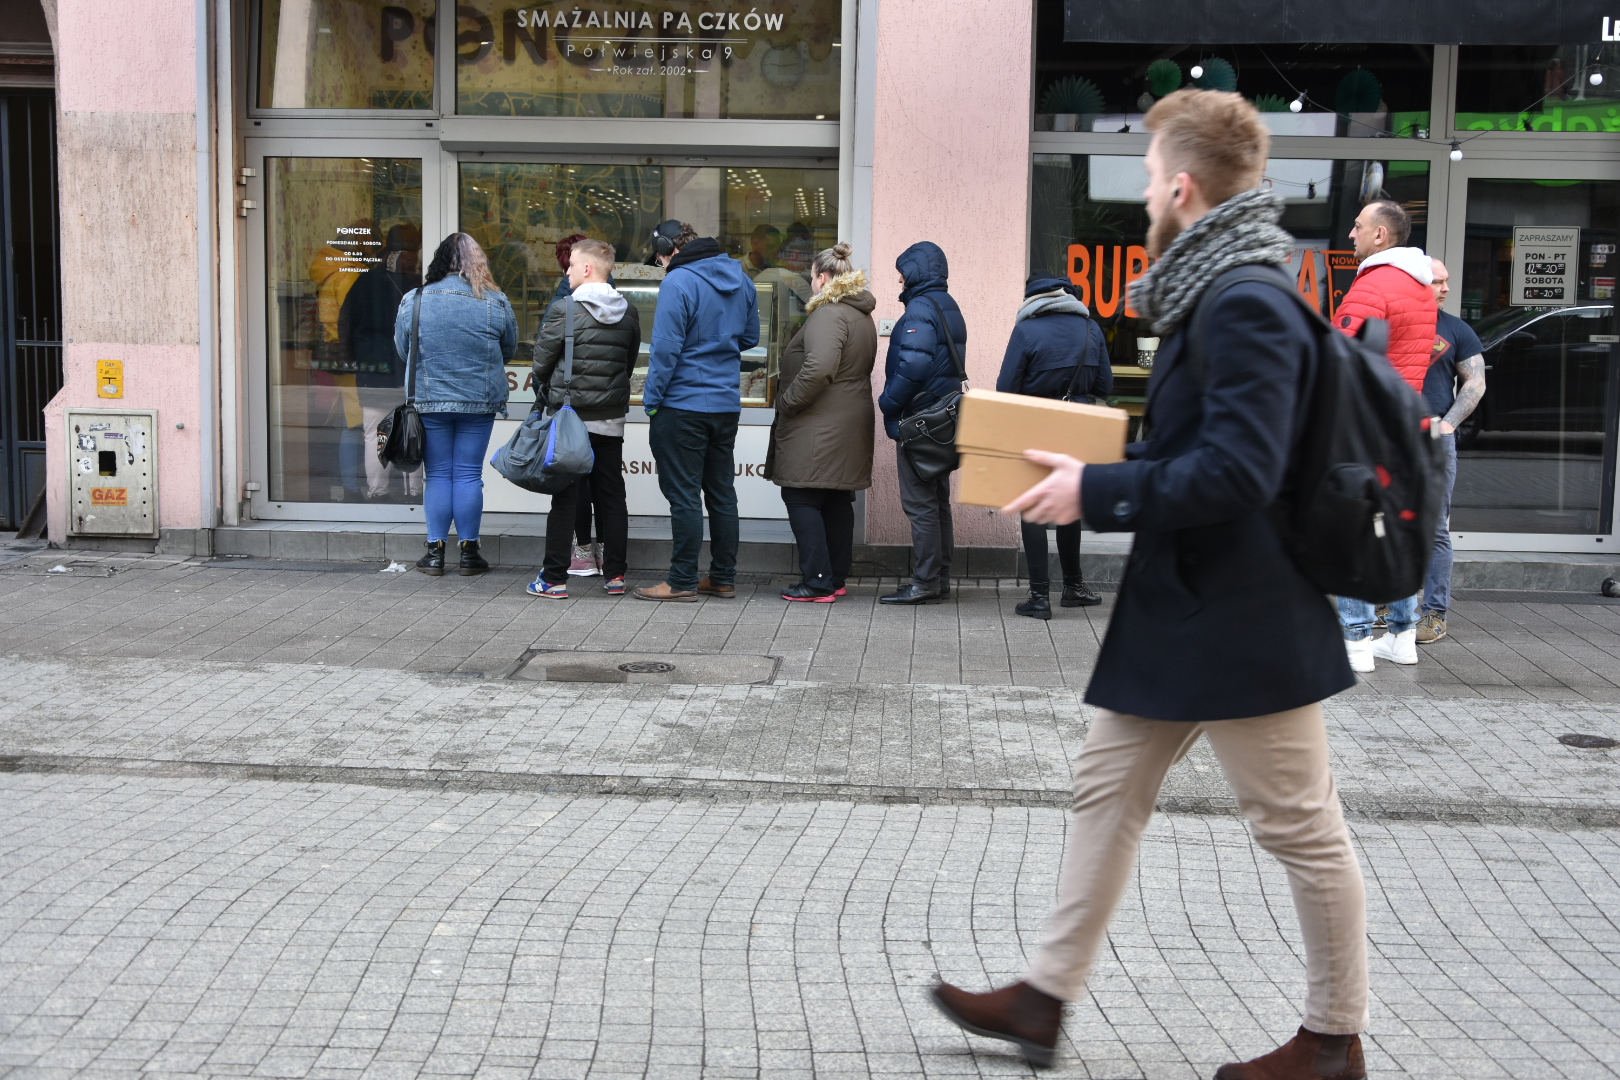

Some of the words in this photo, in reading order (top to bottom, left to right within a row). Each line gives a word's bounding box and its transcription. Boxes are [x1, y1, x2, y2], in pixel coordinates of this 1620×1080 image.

[517, 6, 654, 29] SMAŻALNIA
[567, 44, 712, 61] Półwiejska
[724, 46, 732, 59] 9
[612, 66, 633, 75] Rok
[636, 67, 656, 75] zał.
[660, 66, 686, 75] 2002
[336, 227, 371, 235] PONCZEK
[1331, 257, 1361, 265] NOWO
[92, 489, 126, 500] GAZ
